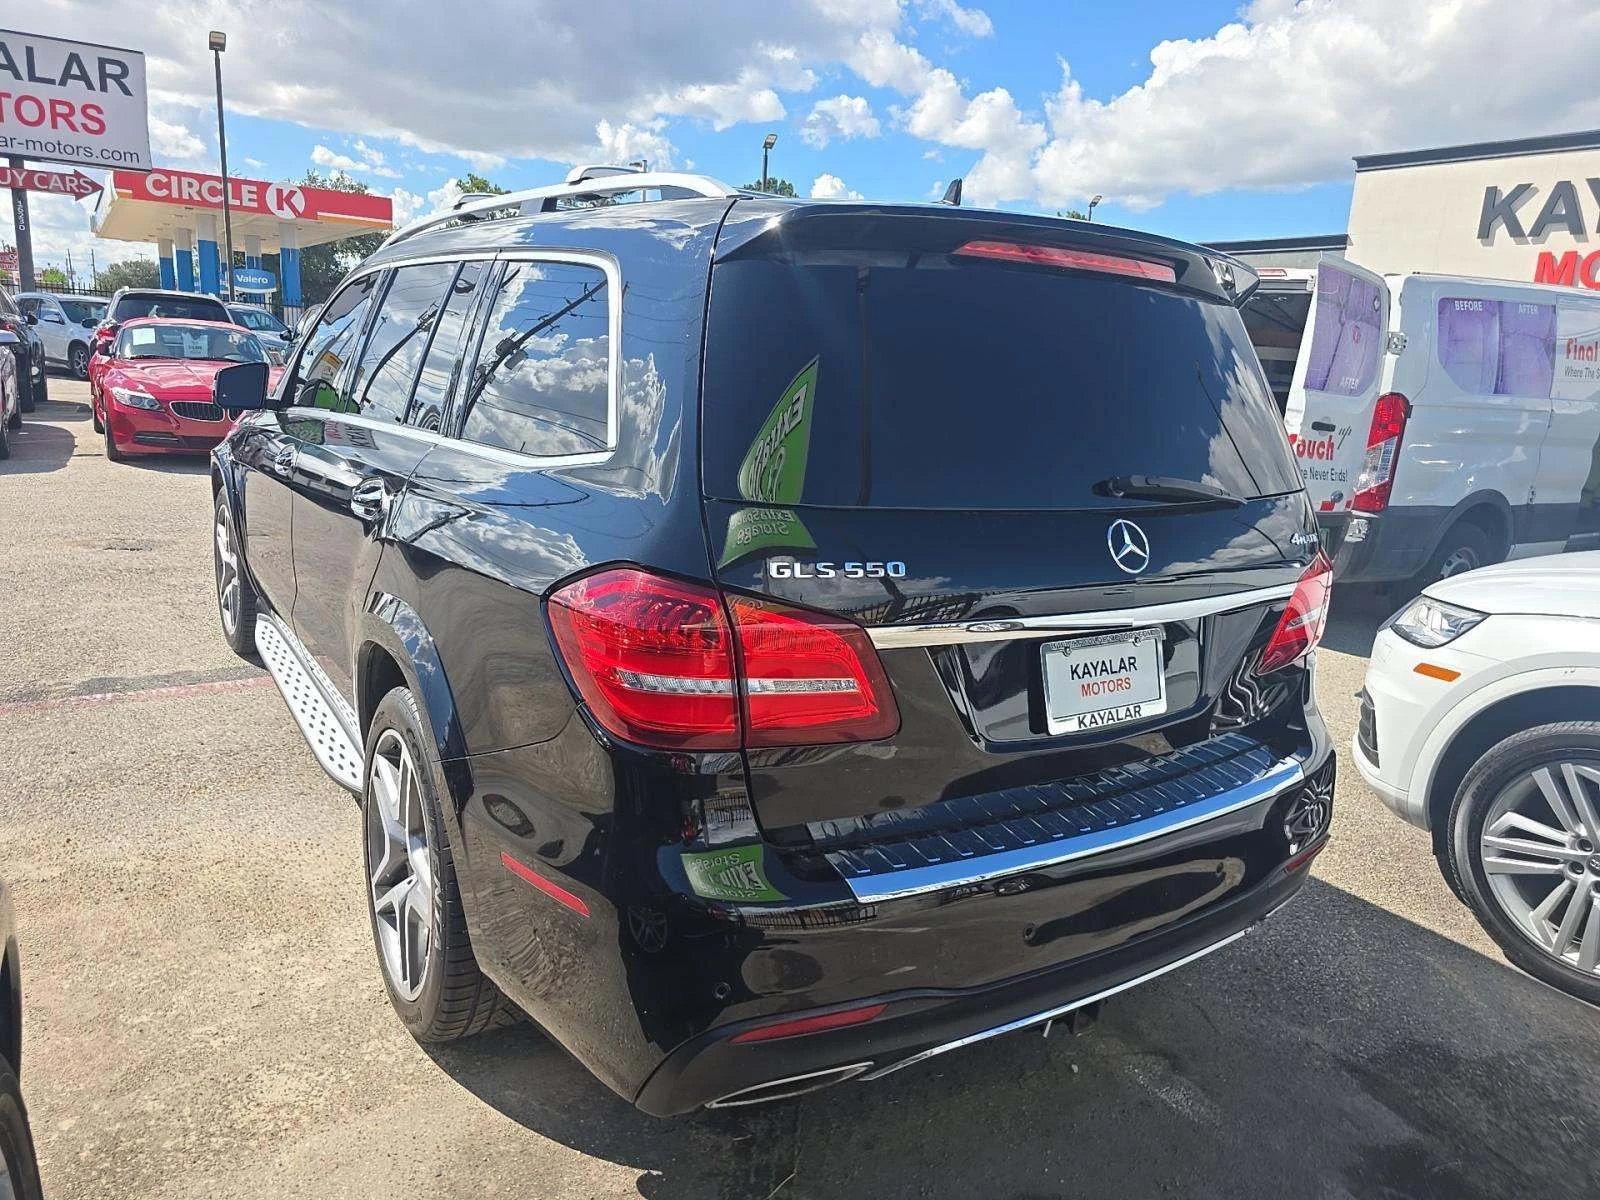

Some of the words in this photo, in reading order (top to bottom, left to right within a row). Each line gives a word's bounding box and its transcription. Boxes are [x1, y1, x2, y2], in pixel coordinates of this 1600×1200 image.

[33, 172, 93, 194] CARS
[145, 173, 258, 208] CIRCLE
[235, 274, 268, 284] Valero
[1454, 300, 1483, 311] BEFORE
[1518, 304, 1538, 314] AFTER
[1566, 337, 1598, 362] Final
[1310, 467, 1329, 480] Never
[769, 562, 836, 579] GLS
[844, 561, 906, 578] 550
[1070, 656, 1138, 681] KAYALAR
[1081, 677, 1132, 697] MOTORS
[1077, 704, 1142, 729] KAYALAR
